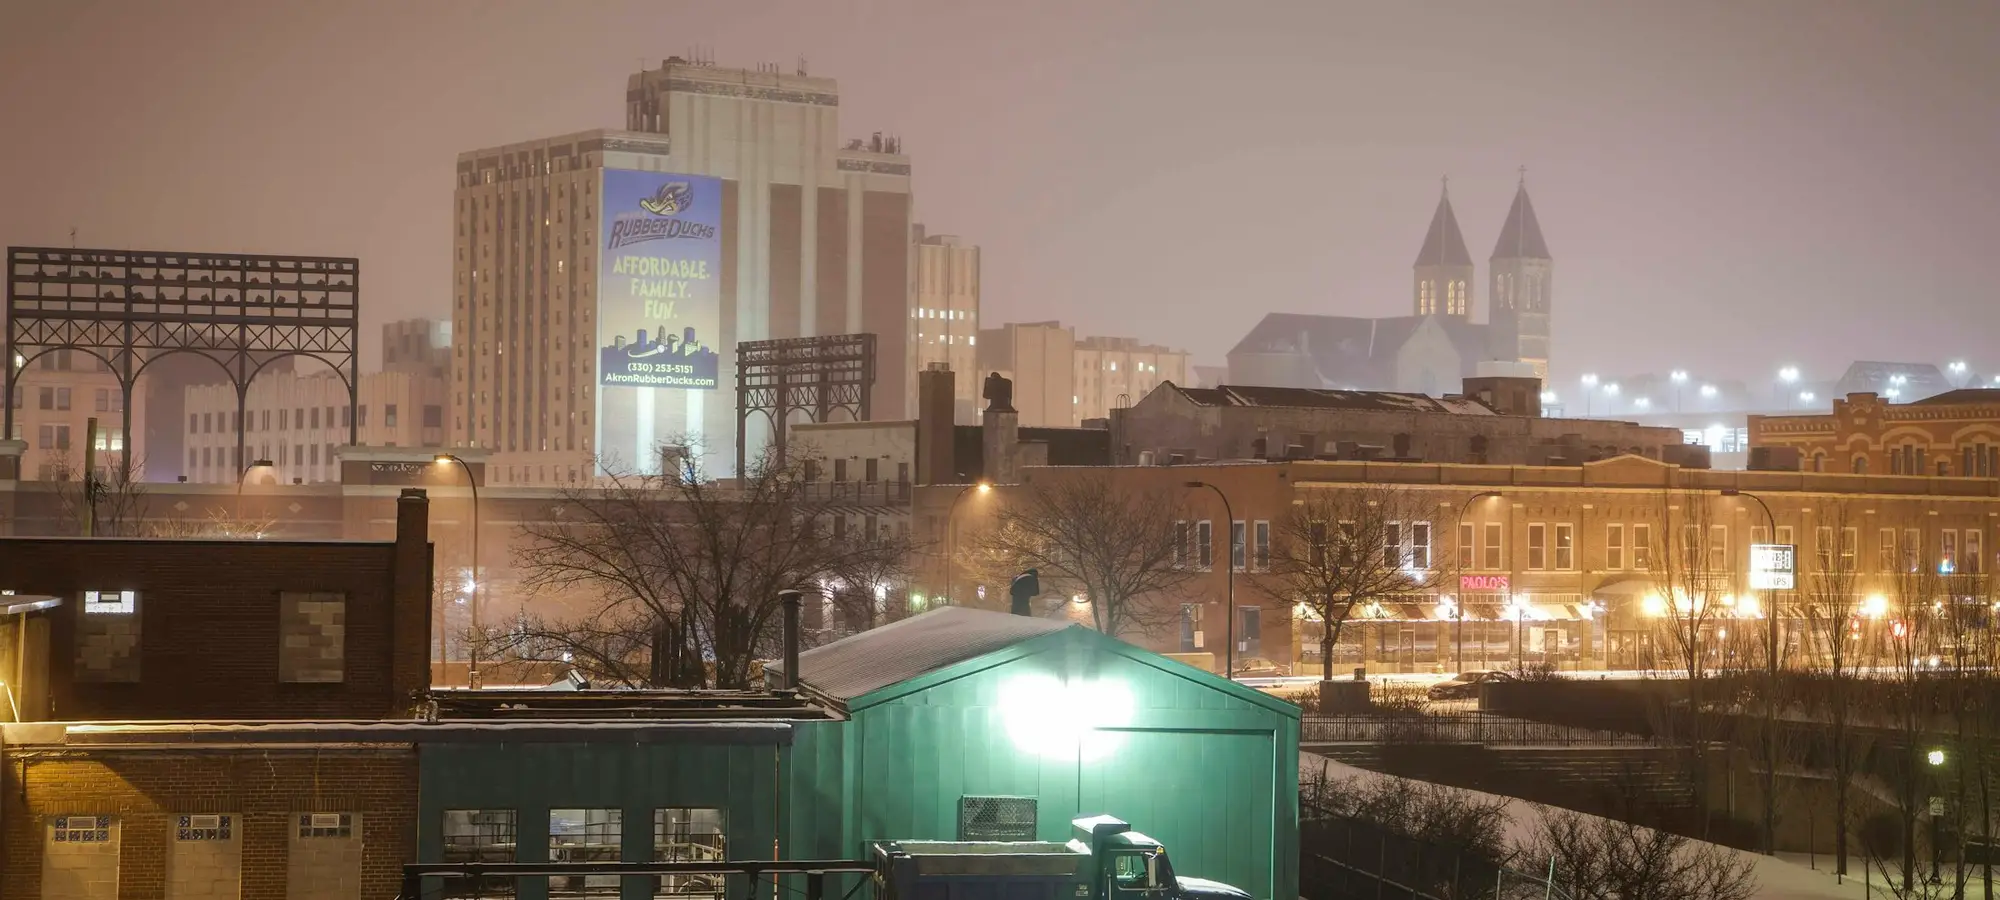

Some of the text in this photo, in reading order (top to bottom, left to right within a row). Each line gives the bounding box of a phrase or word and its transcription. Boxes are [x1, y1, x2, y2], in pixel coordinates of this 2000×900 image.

[612, 255, 710, 280] AFFORDABLE.
[630, 277, 692, 298] FAMILY.
[644, 299, 678, 320] FUN.
[627, 362, 693, 374] (330) 253-5151
[605, 372, 715, 386] AkronRubberDucks.com
[1461, 575, 1509, 590] PAOLO'S
